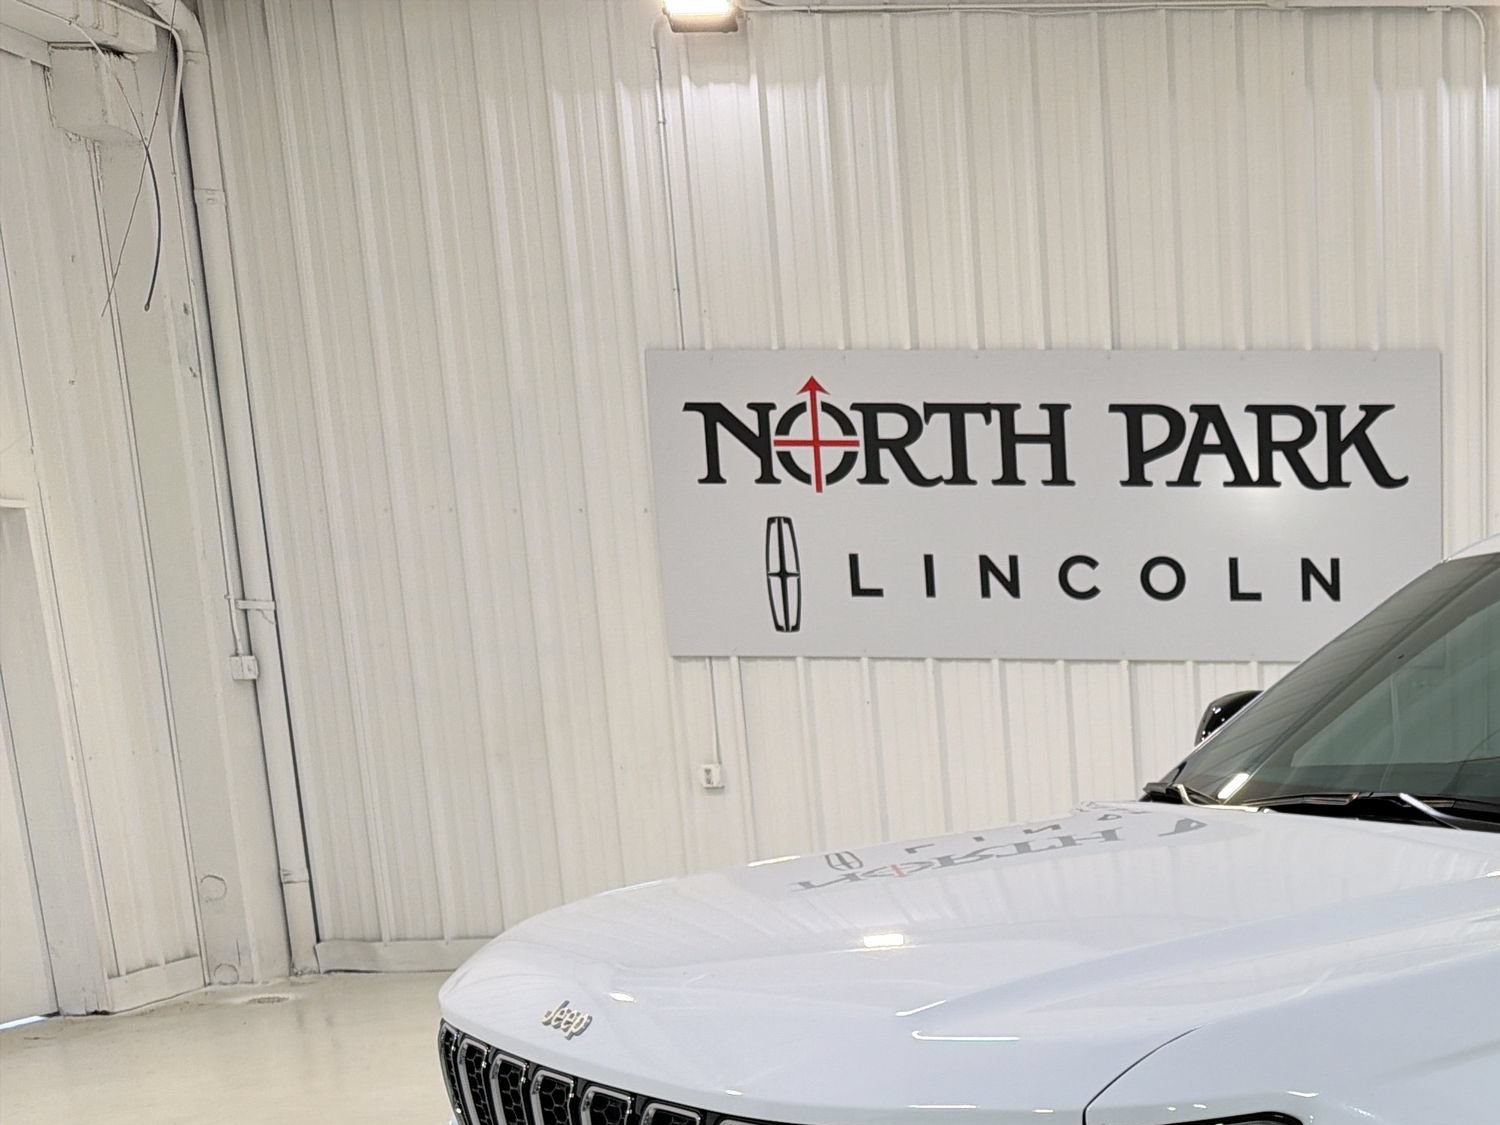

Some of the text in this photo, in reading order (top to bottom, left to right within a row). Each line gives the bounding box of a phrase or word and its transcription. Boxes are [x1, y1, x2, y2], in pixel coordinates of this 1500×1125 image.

[682, 397, 1409, 491] NORTH PARK
[848, 552, 1341, 603] LINCOLN
[541, 999, 593, 1041] Jeep
